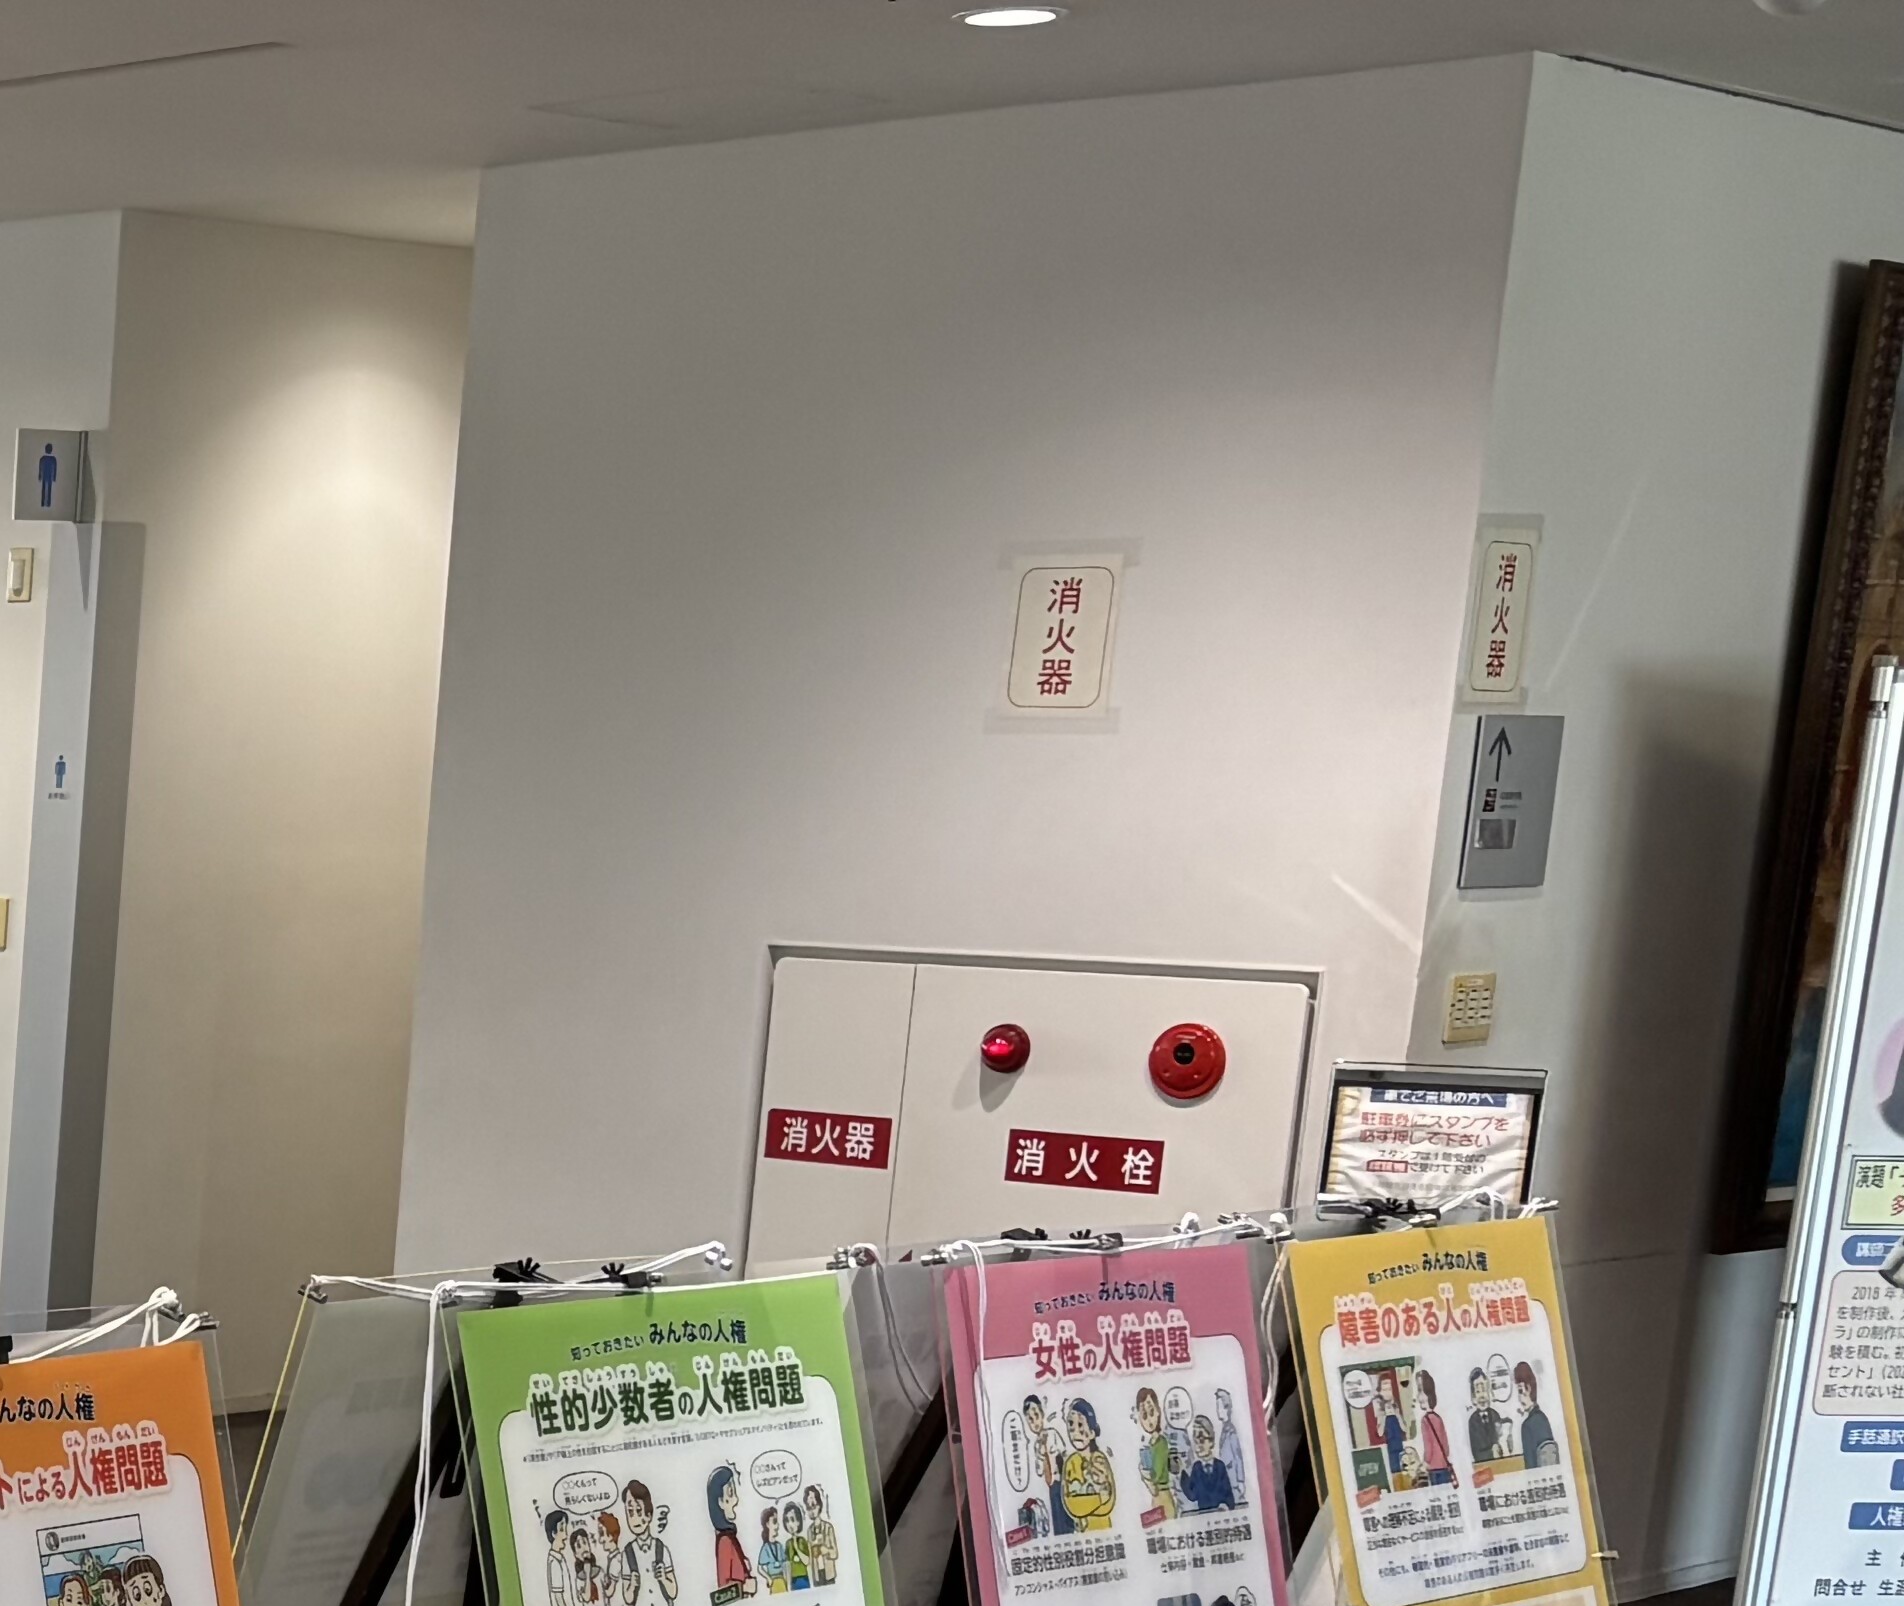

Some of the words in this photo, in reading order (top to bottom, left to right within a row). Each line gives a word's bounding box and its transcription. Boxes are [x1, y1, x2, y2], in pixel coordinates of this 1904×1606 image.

[1036, 576, 1082, 696] 消火器
[1484, 552, 1518, 679] 消火器
[779, 1116, 876, 1160] 消火器
[1013, 1138, 1157, 1187] 消火栓
[1422, 1251, 1489, 1273] みんなの人権
[1098, 1281, 1176, 1303] みんなの人権
[570, 1335, 644, 1361] 知っておきたい
[648, 1319, 747, 1346] みんなの人権
[1339, 1295, 1530, 1348] 障害のある人の人権問題
[1032, 1324, 1191, 1380] 女性の人権問題
[531, 1364, 805, 1438] 性的少数者の人権問題
[1814, 1579, 1866, 1596] 問合せ
